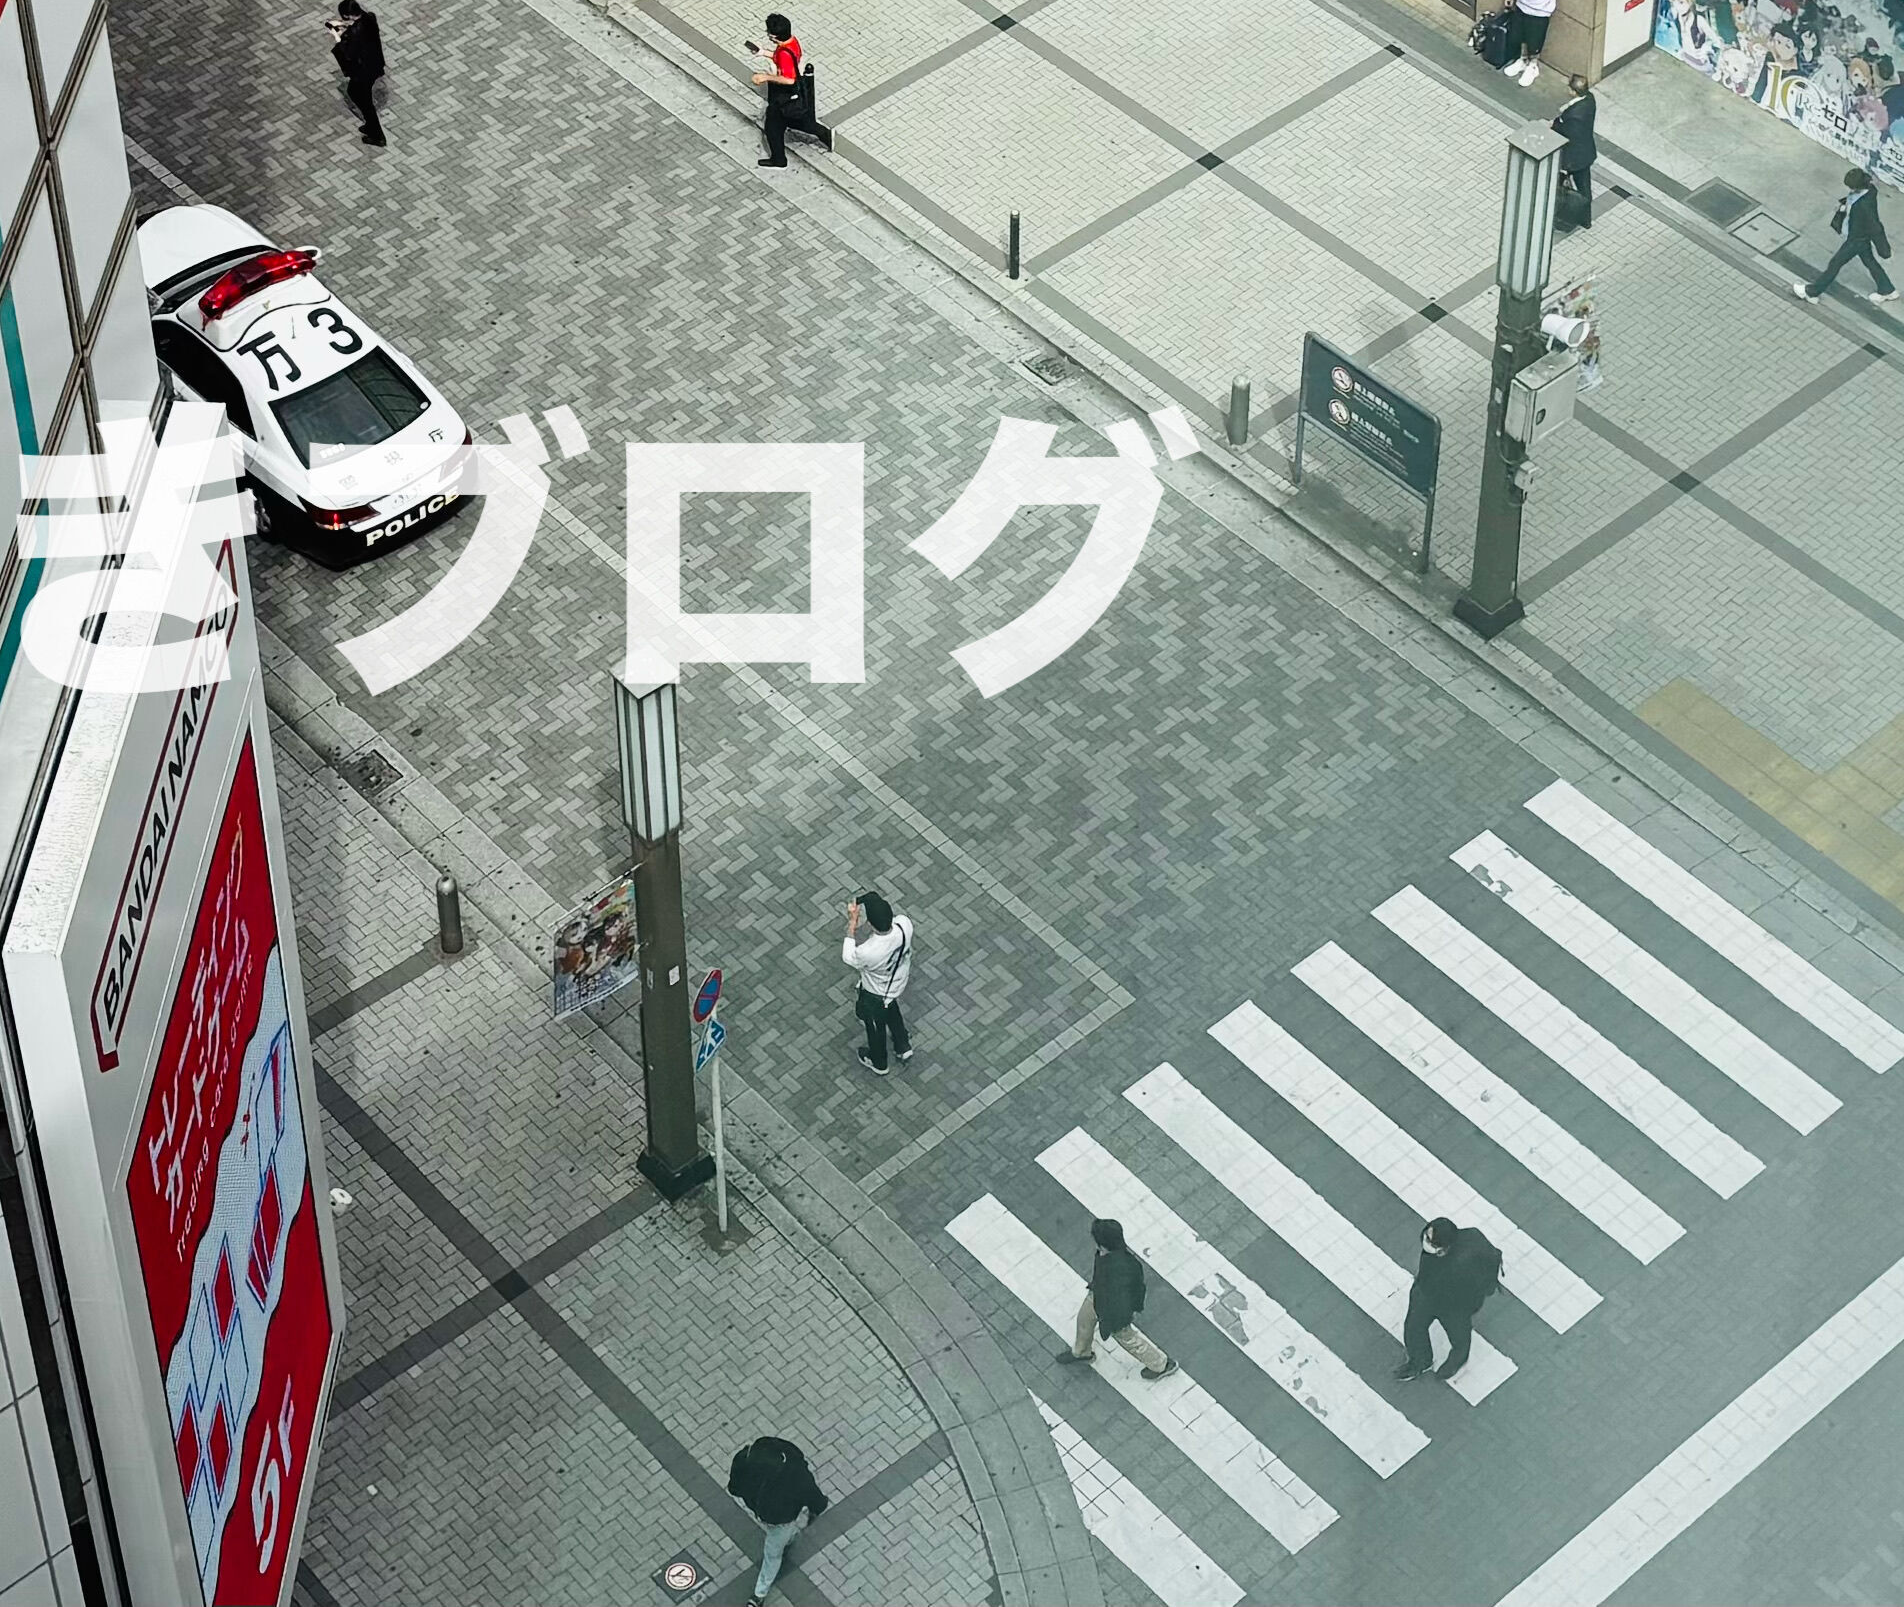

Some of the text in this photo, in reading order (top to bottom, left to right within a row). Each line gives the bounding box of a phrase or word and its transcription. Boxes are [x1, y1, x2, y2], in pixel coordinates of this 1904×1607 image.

[365, 485, 460, 548] POLICE
[100, 785, 170, 1031] BANDAI
[165, 916, 250, 1234] カードゲーム
[249, 1373, 297, 1577] 5F
